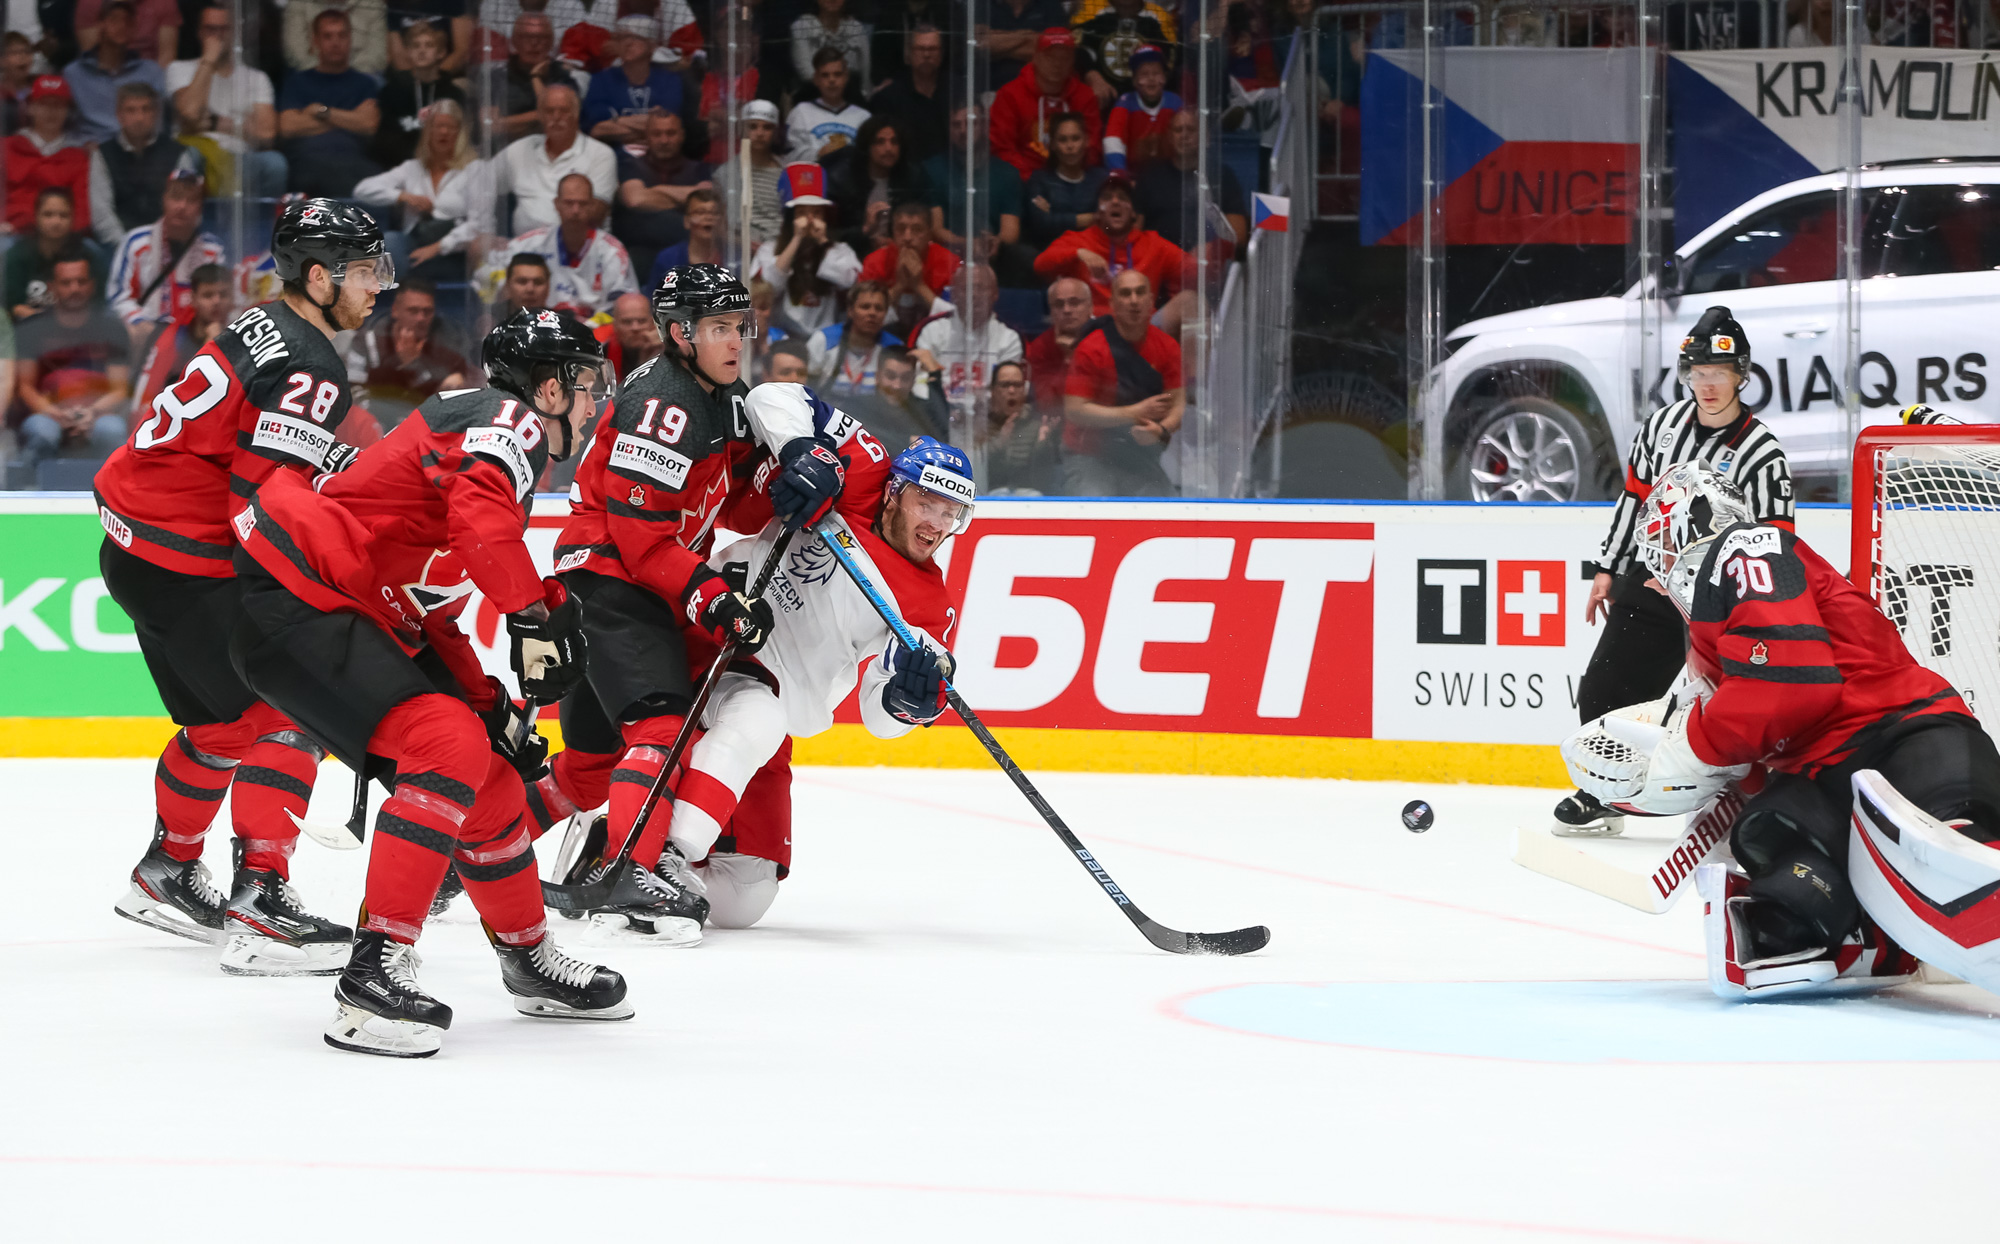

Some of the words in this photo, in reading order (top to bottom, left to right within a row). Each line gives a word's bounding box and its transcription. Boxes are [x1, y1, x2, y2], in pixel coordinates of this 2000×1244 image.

[279, 372, 339, 423] 28
[1917, 352, 1987, 402] RS
[492, 399, 543, 451] 16
[636, 398, 687, 444] 19
[731, 395, 748, 437] C
[277, 437, 304, 449] WATCHES
[283, 424, 329, 452] TISSOT
[494, 433, 529, 485] TISSOT
[636, 445, 687, 473] TISSOT
[614, 453, 629, 461] SWISS
[630, 457, 653, 468] WATCHES
[654, 465, 669, 476] SINCE
[946, 454, 963, 468] 79
[1779, 479, 1791, 497] 15
[766, 581, 792, 613] EPUBLIC
[772, 565, 805, 611] CZECH
[1727, 556, 1774, 600] 30
[1415, 671, 1544, 709] SWISS
[1652, 787, 1746, 900] WARRIOR
